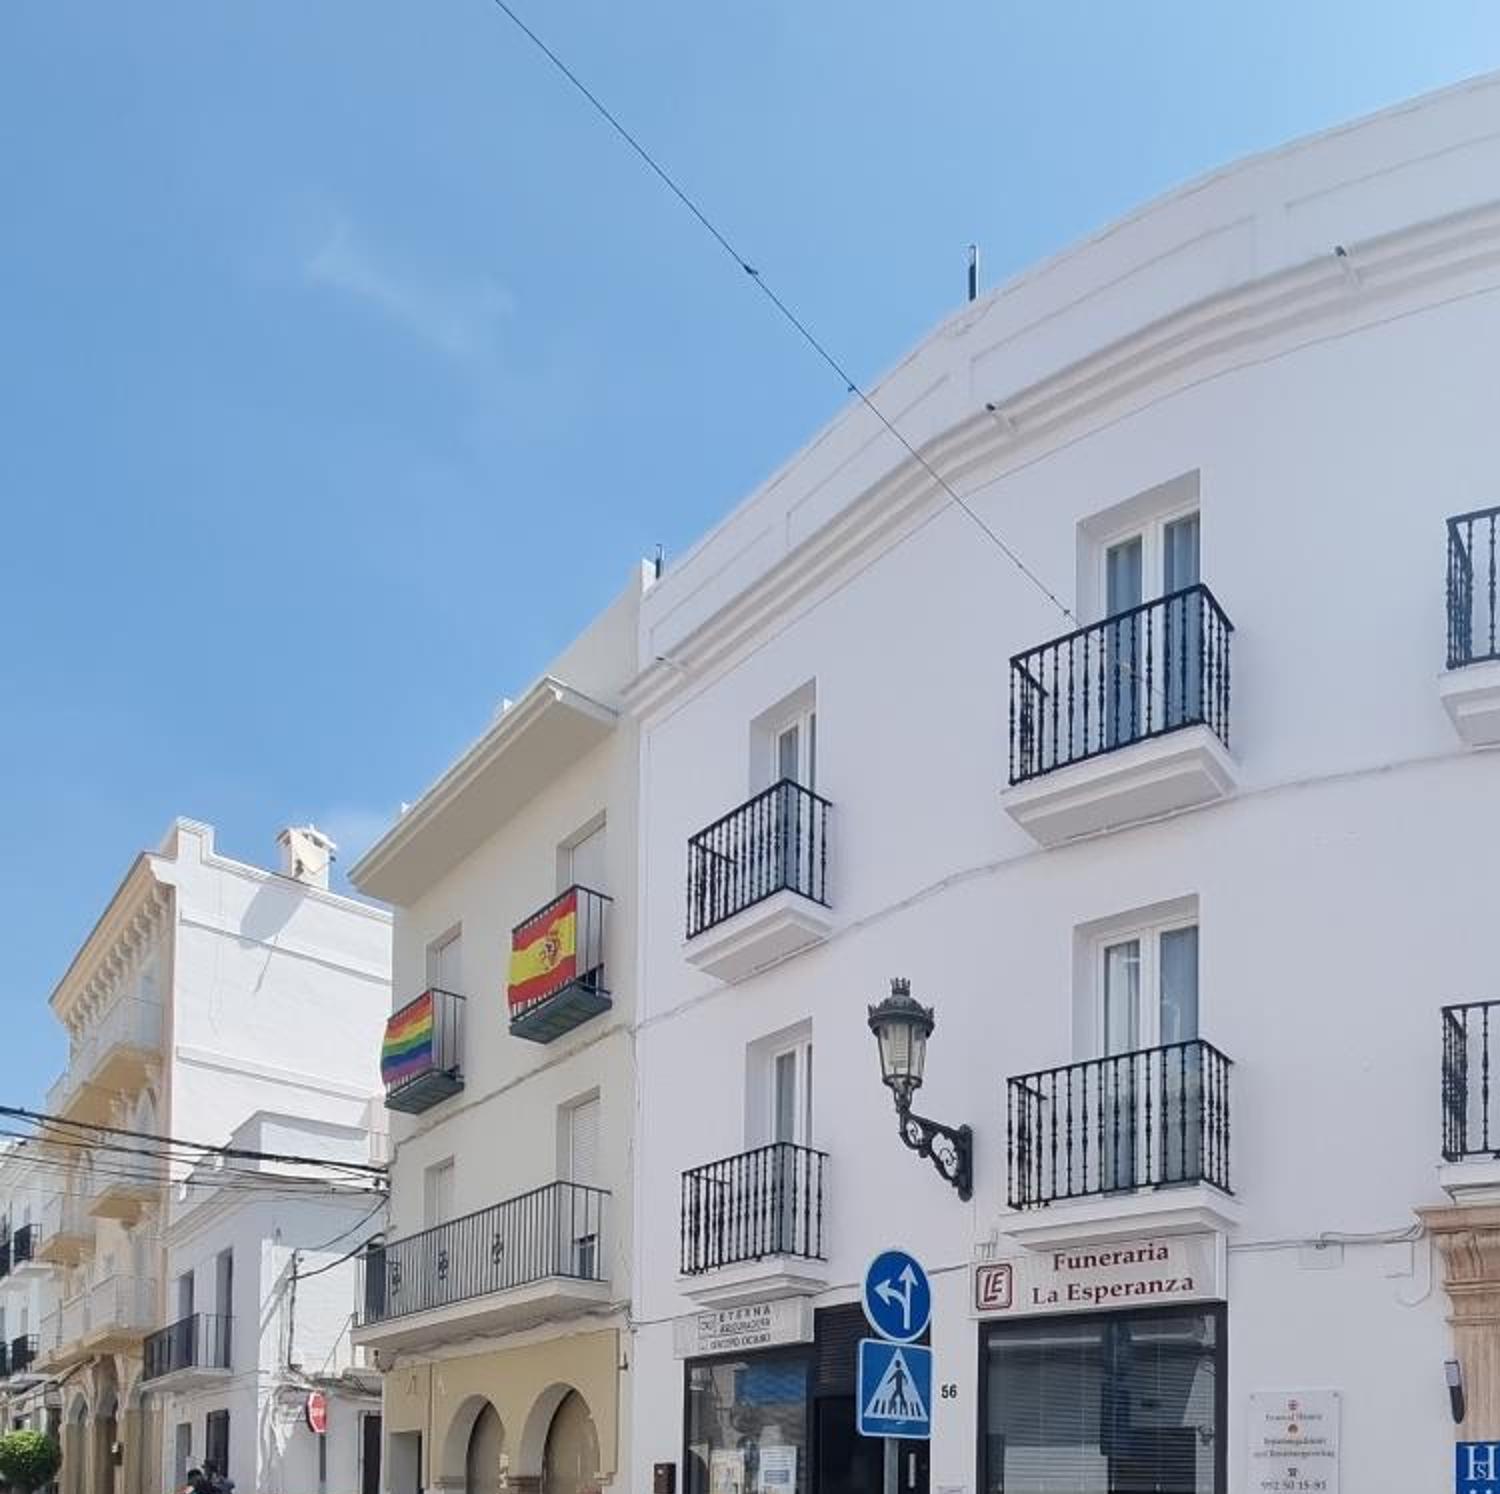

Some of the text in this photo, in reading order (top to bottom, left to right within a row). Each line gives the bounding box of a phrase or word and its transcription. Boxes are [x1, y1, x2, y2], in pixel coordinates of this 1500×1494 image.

[1053, 1242, 1169, 1271] Funeraria
[1032, 1276, 1194, 1305] La Esperanza
[941, 1384, 957, 1399] 56
